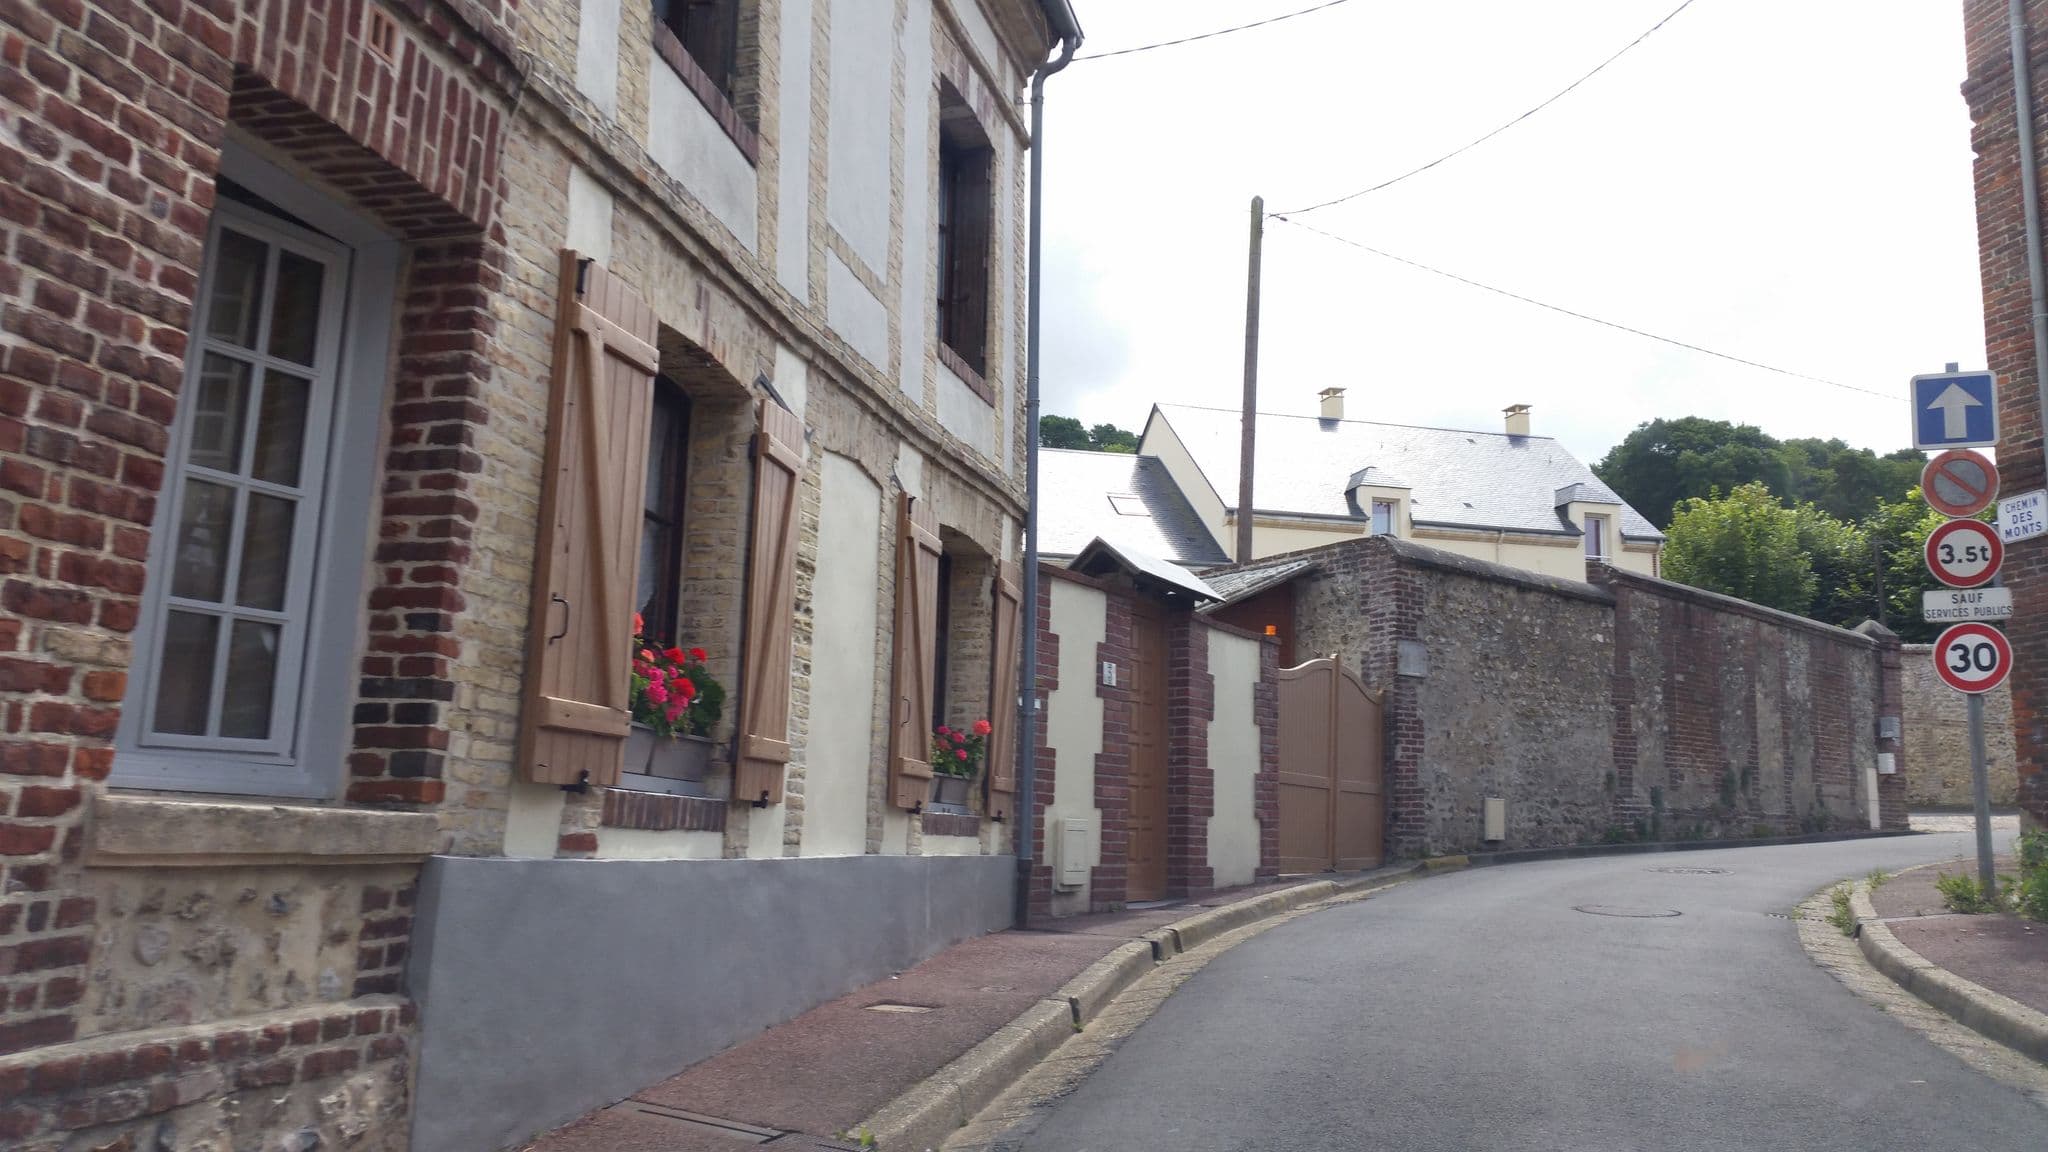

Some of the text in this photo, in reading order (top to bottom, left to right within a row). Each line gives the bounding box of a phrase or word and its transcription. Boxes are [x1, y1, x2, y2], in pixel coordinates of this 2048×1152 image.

[2005, 496, 2038, 513] CHEMIN
[2012, 510, 2033, 524] DES
[2005, 521, 2042, 538] MONTS
[1951, 592, 1984, 604] SAUF
[1925, 605, 2013, 619] SERVICES PUBLICS
[1950, 642, 1997, 673] 30
